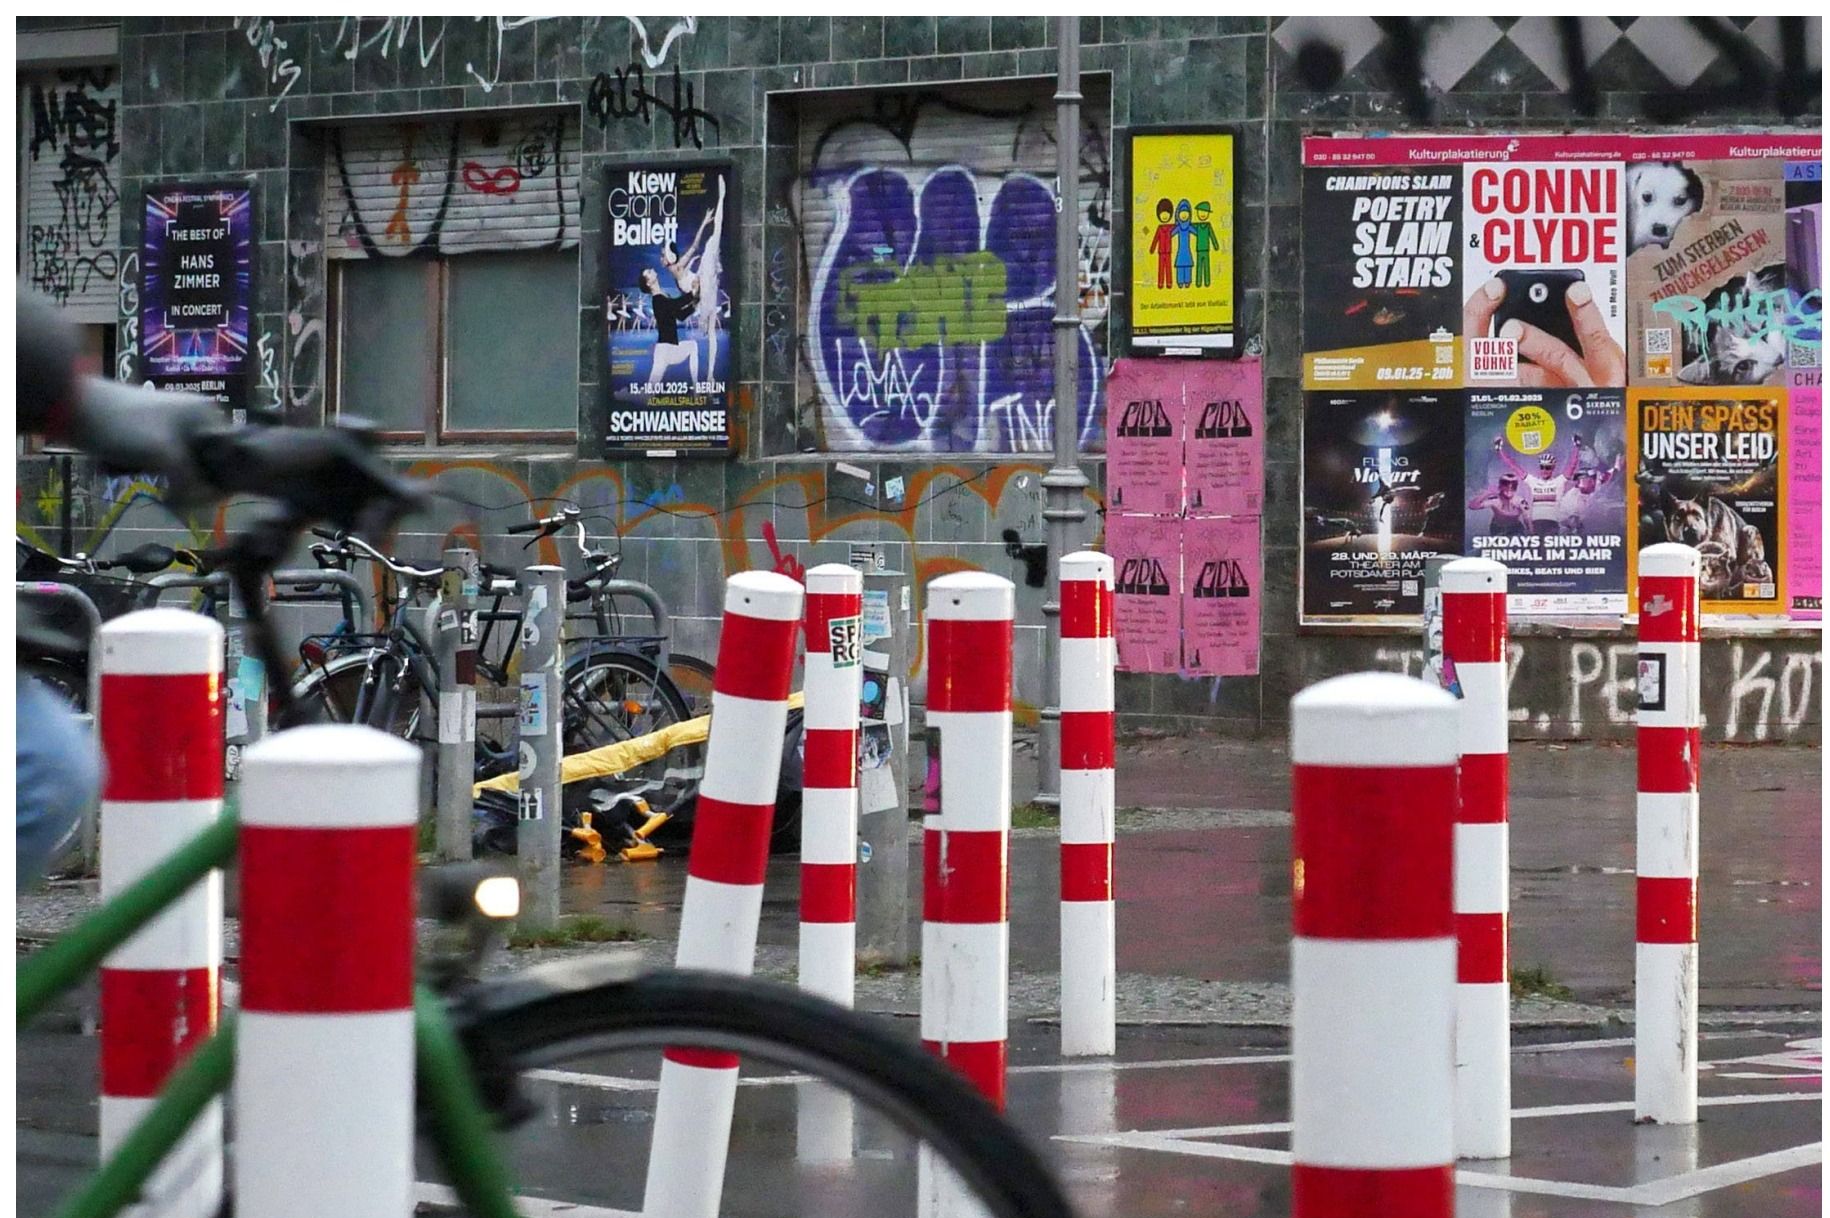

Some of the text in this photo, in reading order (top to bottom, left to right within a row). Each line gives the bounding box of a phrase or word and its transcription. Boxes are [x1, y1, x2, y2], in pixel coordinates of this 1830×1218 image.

[1408, 147, 1509, 161] Kulturplakatierung
[628, 170, 676, 194] Kiew
[1326, 174, 1453, 191] CHAMPIONS SLAM
[1471, 168, 1617, 215] CONNI
[608, 187, 678, 218] Grand
[1352, 196, 1453, 221] POETRY
[172, 229, 225, 241] THE BEST OF
[613, 217, 678, 246] Ballett
[1352, 221, 1453, 256] SLAM
[1469, 218, 1618, 264] & CLYDE
[1652, 218, 1745, 282] ZUM STERBEN
[181, 254, 214, 269] HANS
[1352, 257, 1454, 289] STARS
[174, 274, 220, 289] ZIMMER
[171, 304, 222, 316] IN CONCERT
[1474, 341, 1514, 355] VOLKS
[1474, 355, 1514, 371] BÜHNE
[1376, 367, 1423, 381] 09.01.25
[1432, 367, 1454, 381] 20h
[201, 380, 226, 391] BERLIN
[630, 382, 688, 394] 15.-18.01.2025
[695, 382, 726, 394] BERLIN
[647, 396, 707, 406] ADMIRALSPALAST
[1566, 393, 1583, 420] 6
[1586, 401, 1621, 409] SIXDAYS
[610, 410, 726, 432] SCHWANENSEE
[1643, 405, 1694, 431] DEIN
[1700, 404, 1773, 432] SPASS
[1643, 432, 1774, 460] UNSER LEID
[1472, 535, 1622, 548] SIXDAYS SIND NUR
[1331, 552, 1350, 561] 28.
[1352, 552, 1378, 560] UND
[1401, 550, 1438, 560] MÄRZ
[1481, 548, 1612, 561] EINMAL IM JAHR
[1349, 560, 1420, 569] THEATER AM
[1535, 567, 1562, 575] BEATS
[1330, 569, 1426, 578] POTSDAMER PLA
